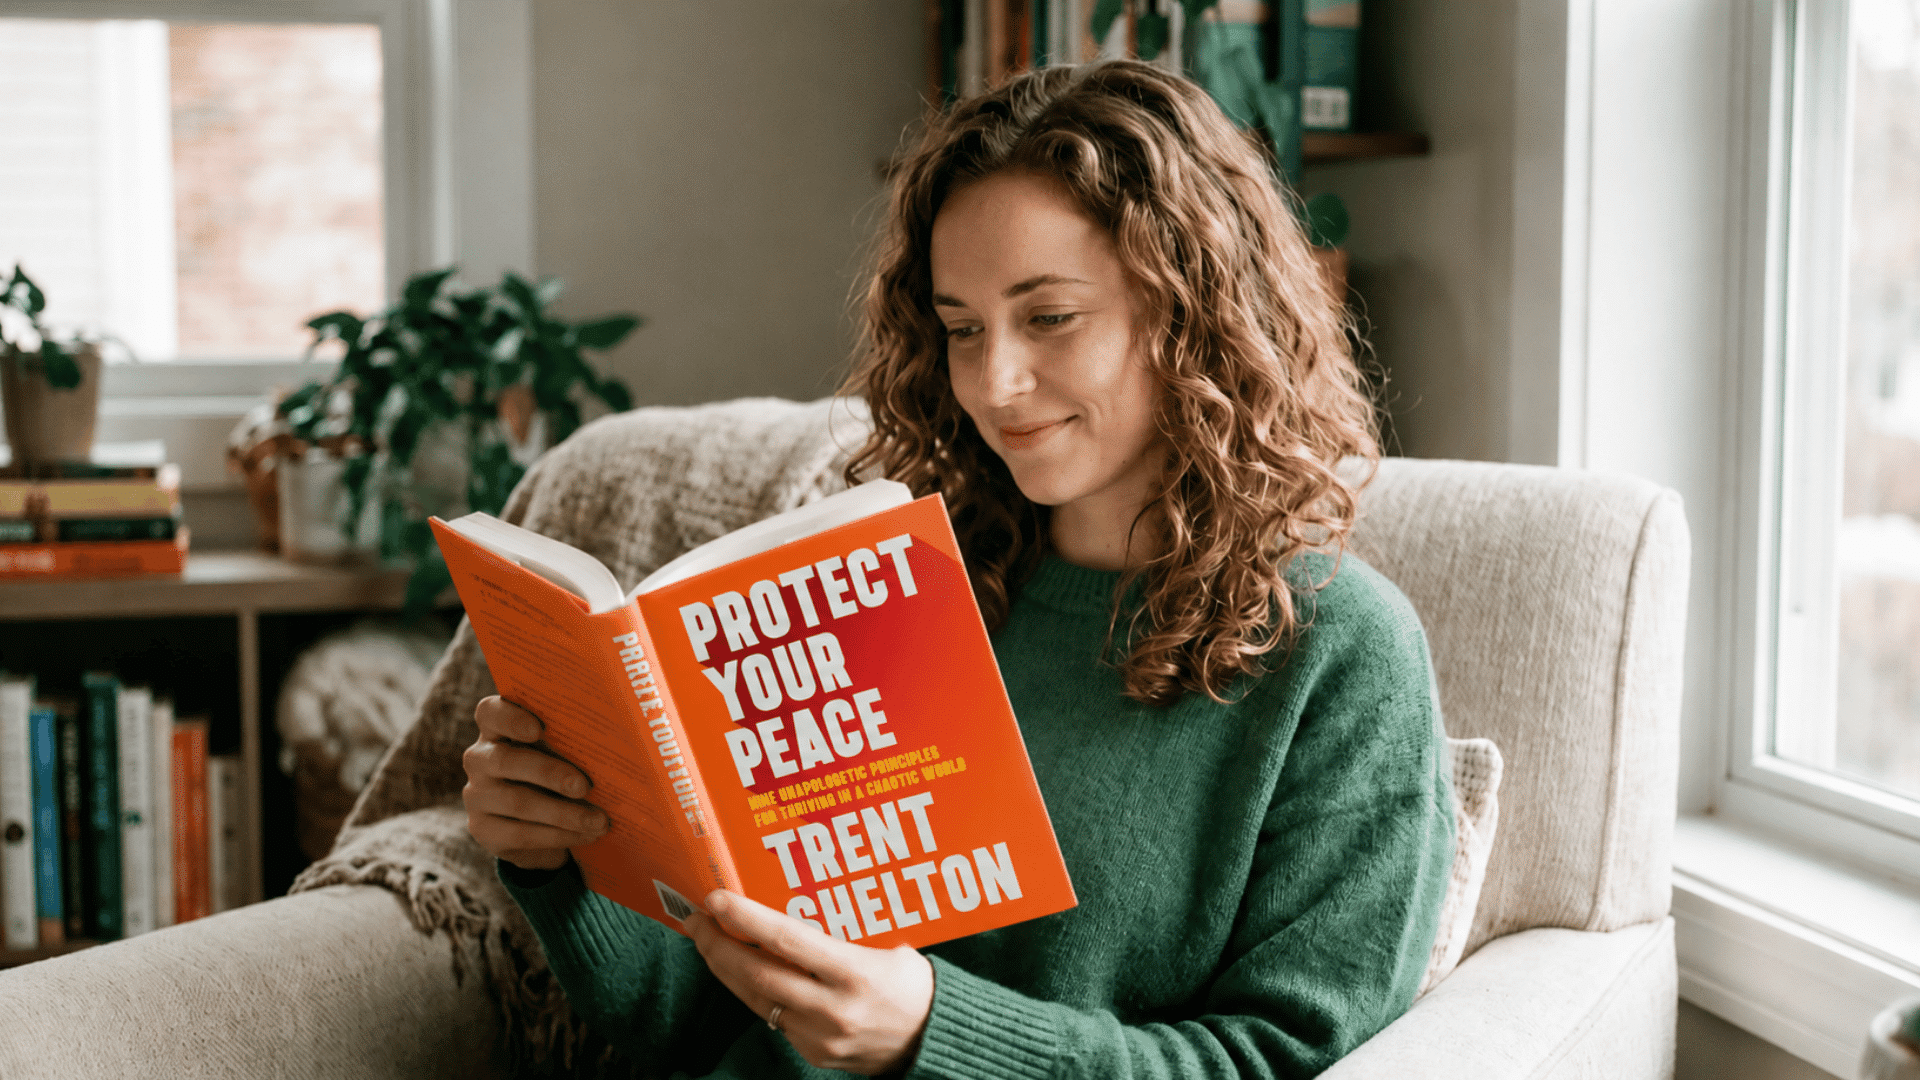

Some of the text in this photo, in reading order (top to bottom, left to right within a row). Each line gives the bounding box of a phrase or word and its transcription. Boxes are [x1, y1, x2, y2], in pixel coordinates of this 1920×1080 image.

[678, 533, 919, 663] PROTECT
[701, 632, 854, 722] YOUR
[724, 687, 898, 788] PEACE
[778, 765, 868, 802] UNAPOLOGETIC
[869, 745, 941, 777] PRINCIPLES
[754, 757, 967, 828] FOR THRIVING IN A CHAOTIC WORLD
[761, 791, 938, 890] TRENT
[785, 841, 1023, 943] SHELTON
